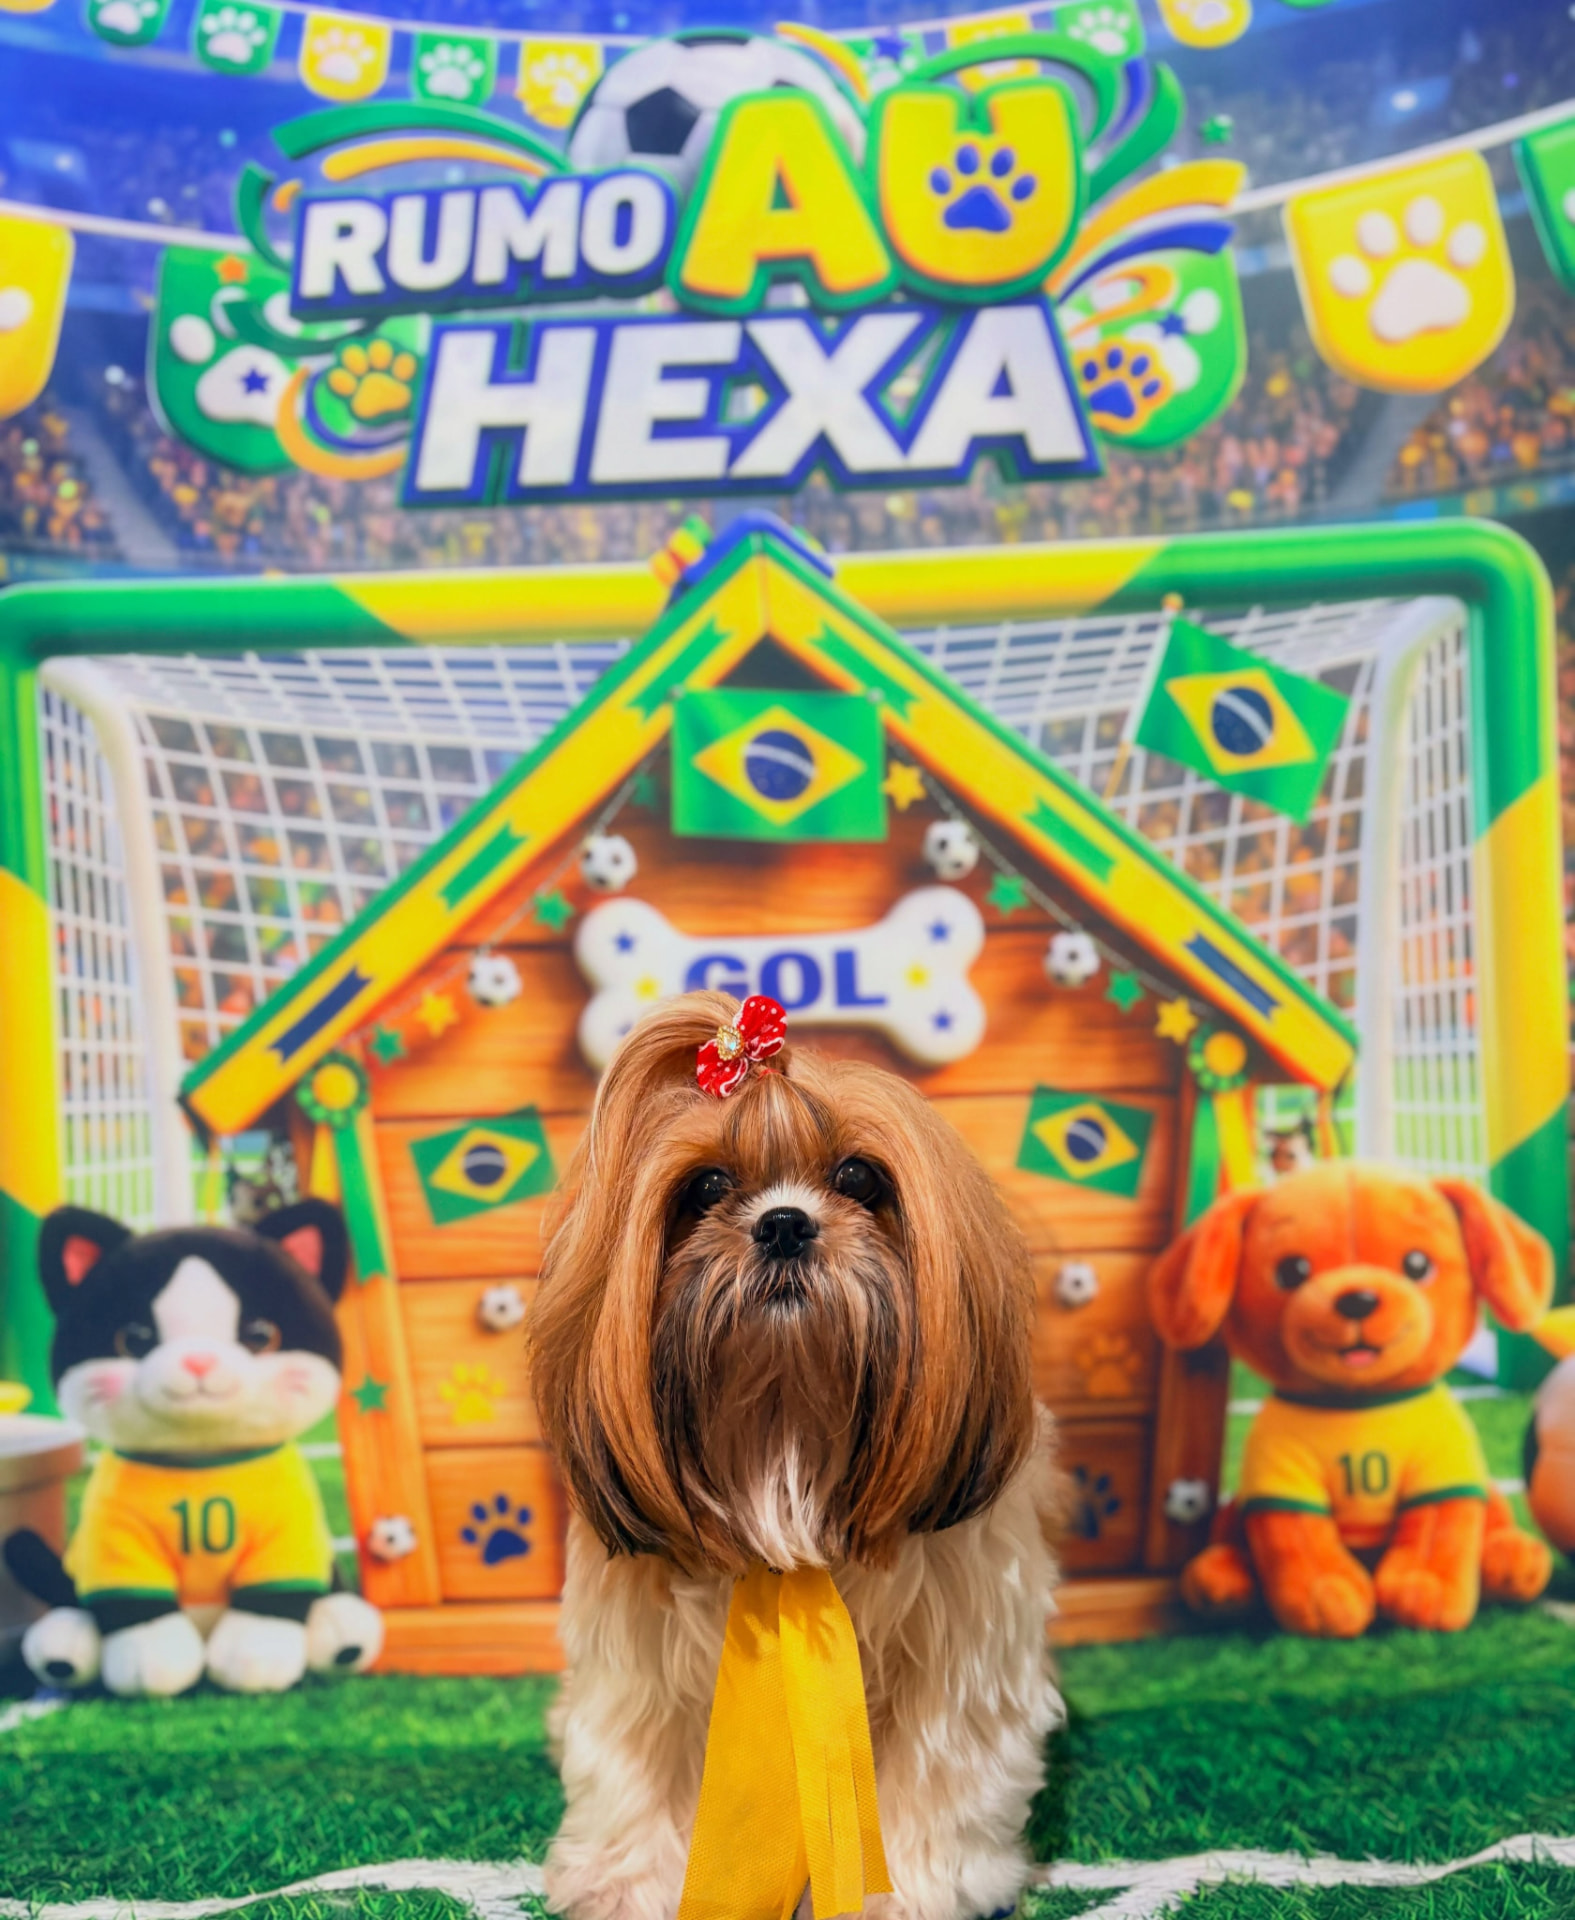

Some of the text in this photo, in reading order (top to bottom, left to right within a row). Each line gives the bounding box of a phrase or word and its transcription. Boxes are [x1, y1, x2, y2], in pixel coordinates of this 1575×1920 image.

[302, 85, 1073, 299] RUMO AU
[414, 305, 1088, 491] HEXA
[685, 949, 888, 1012] GOL
[1338, 1450, 1390, 1496] 10
[170, 1496, 236, 1556] 10
